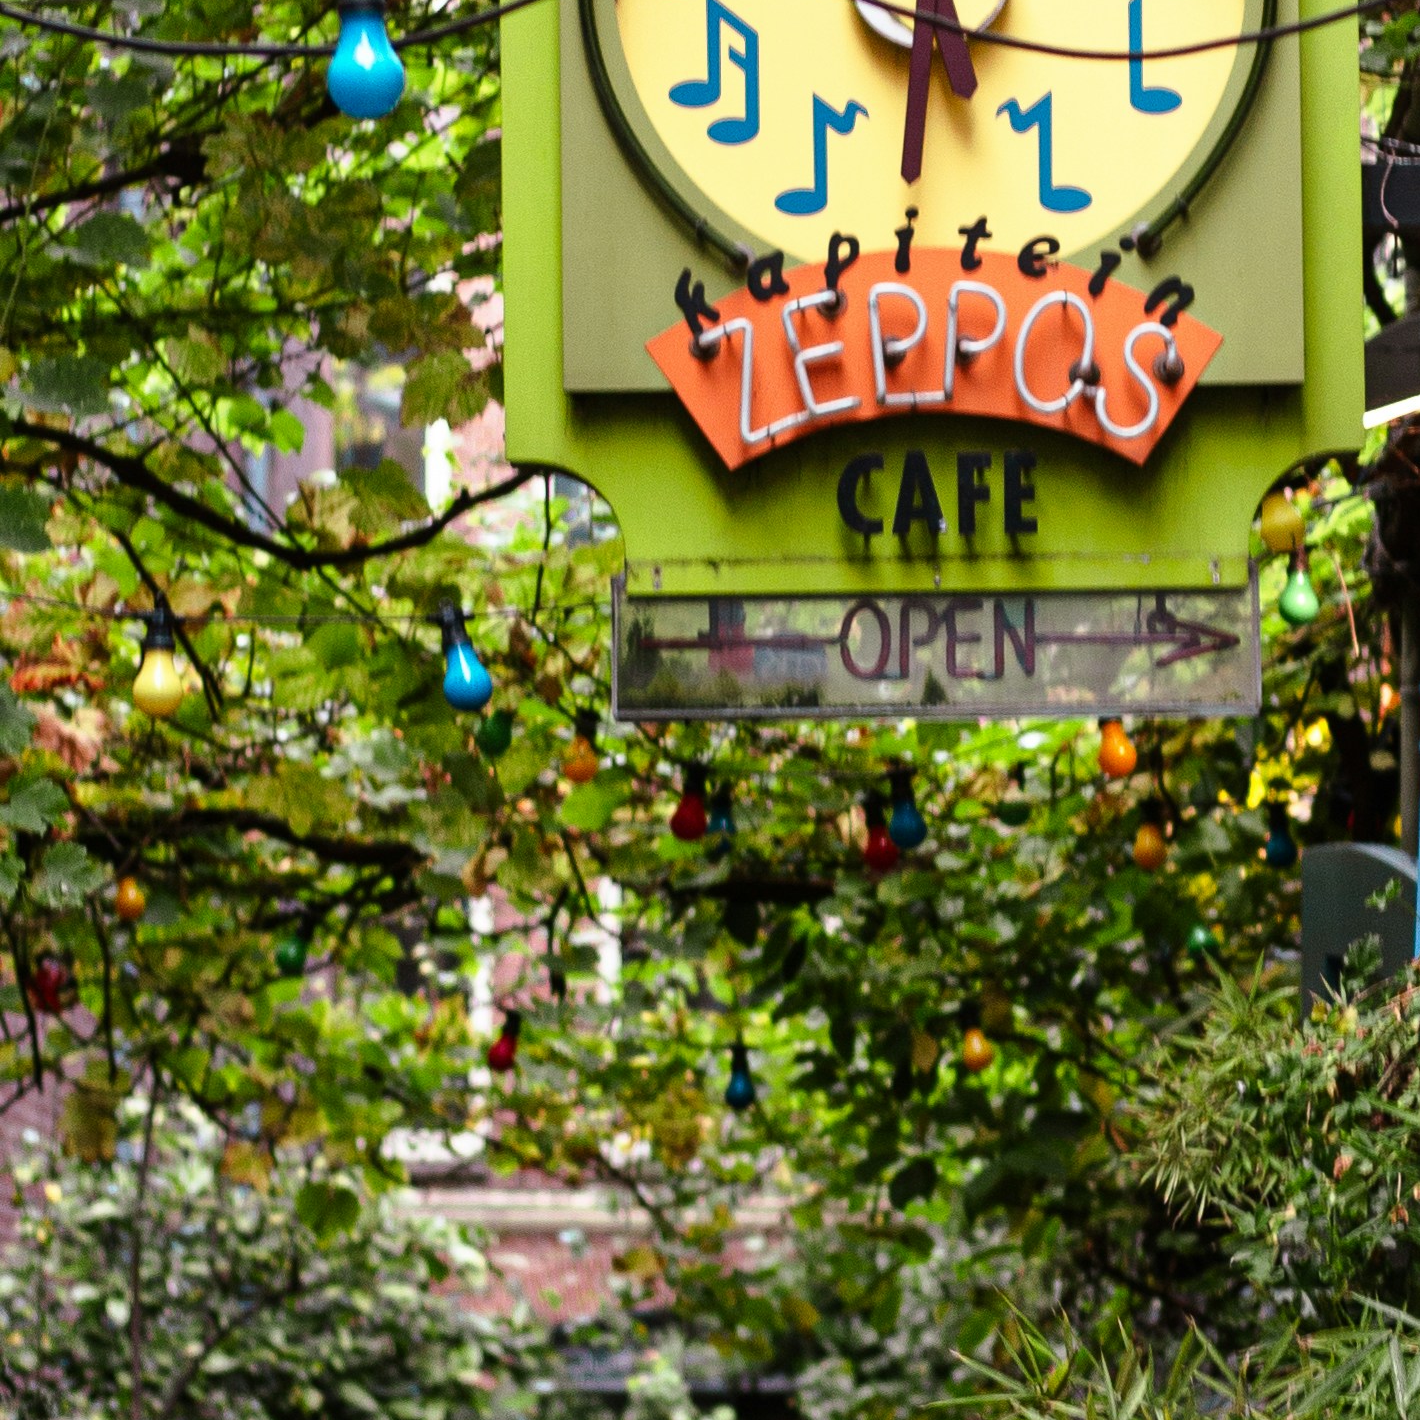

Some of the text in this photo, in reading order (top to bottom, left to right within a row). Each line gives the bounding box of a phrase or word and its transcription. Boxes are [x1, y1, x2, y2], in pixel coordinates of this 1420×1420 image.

[694, 281, 1186, 443] ZEPPOS
[836, 449, 1040, 537] CAFE
[839, 597, 1039, 681] OPEN
